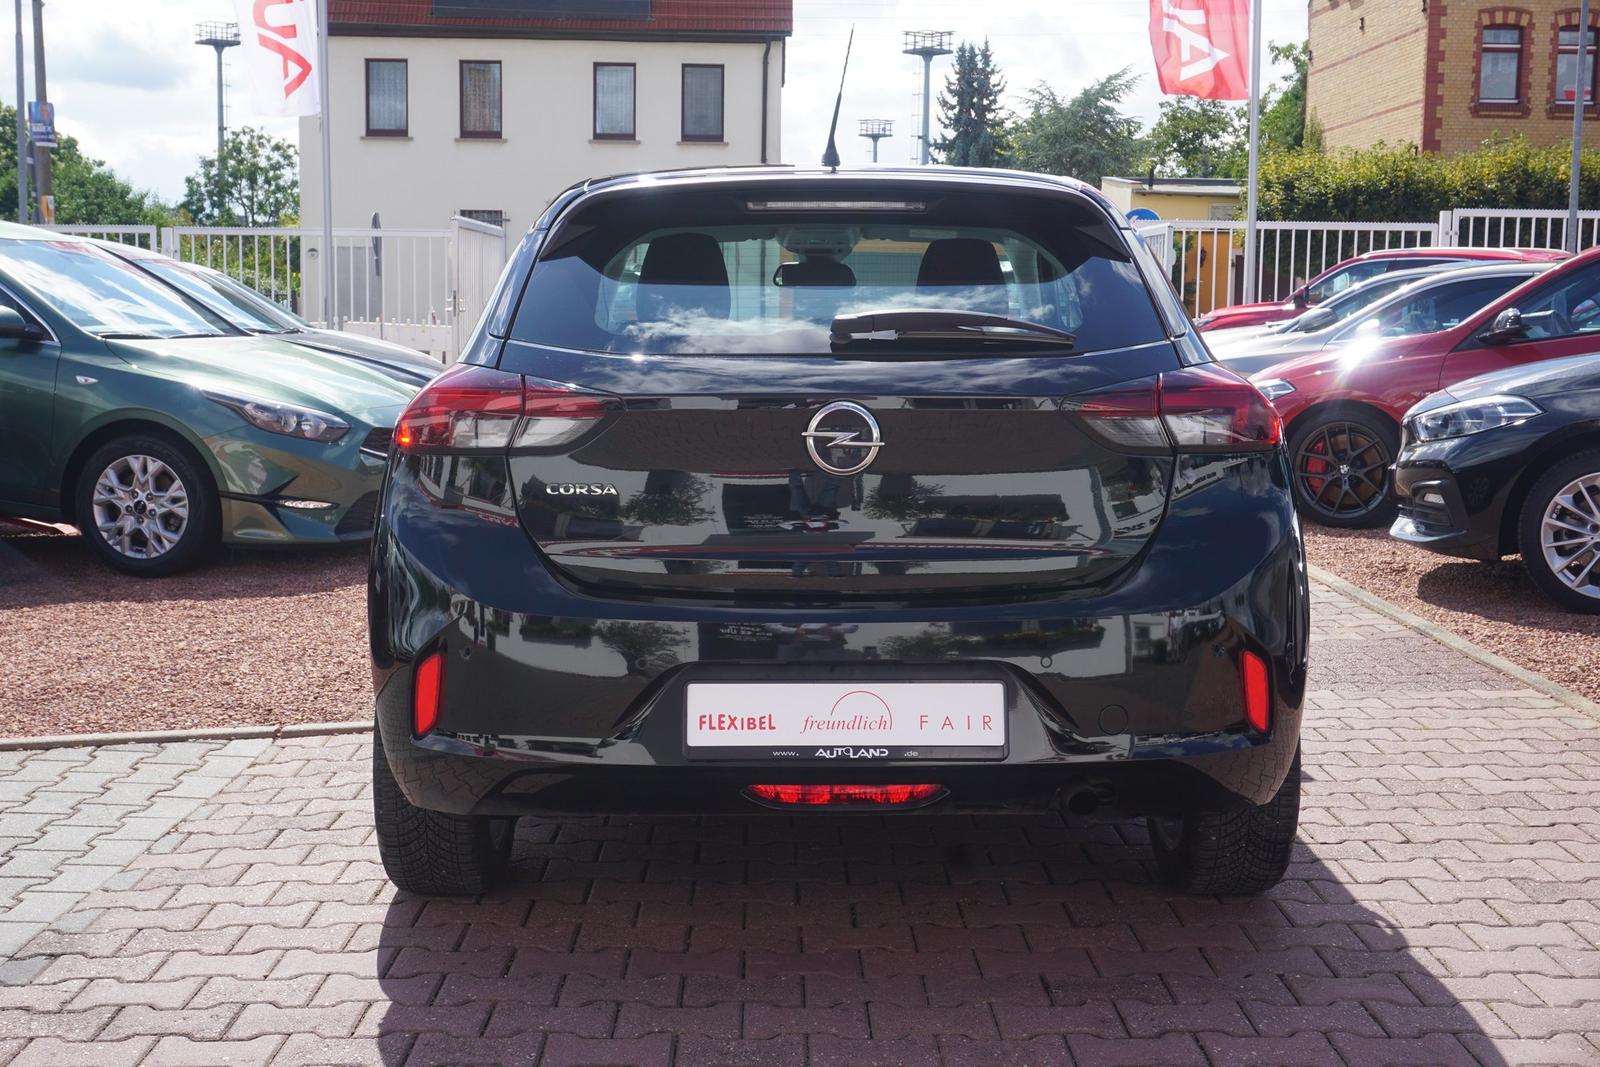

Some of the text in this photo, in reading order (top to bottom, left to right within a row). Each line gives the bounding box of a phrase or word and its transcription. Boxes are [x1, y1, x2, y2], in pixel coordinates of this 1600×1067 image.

[545, 483, 619, 496] CORSA
[699, 713, 993, 734] FLEXIBEL freundlich FAIR
[814, 746, 889, 759] AUTOLAND
